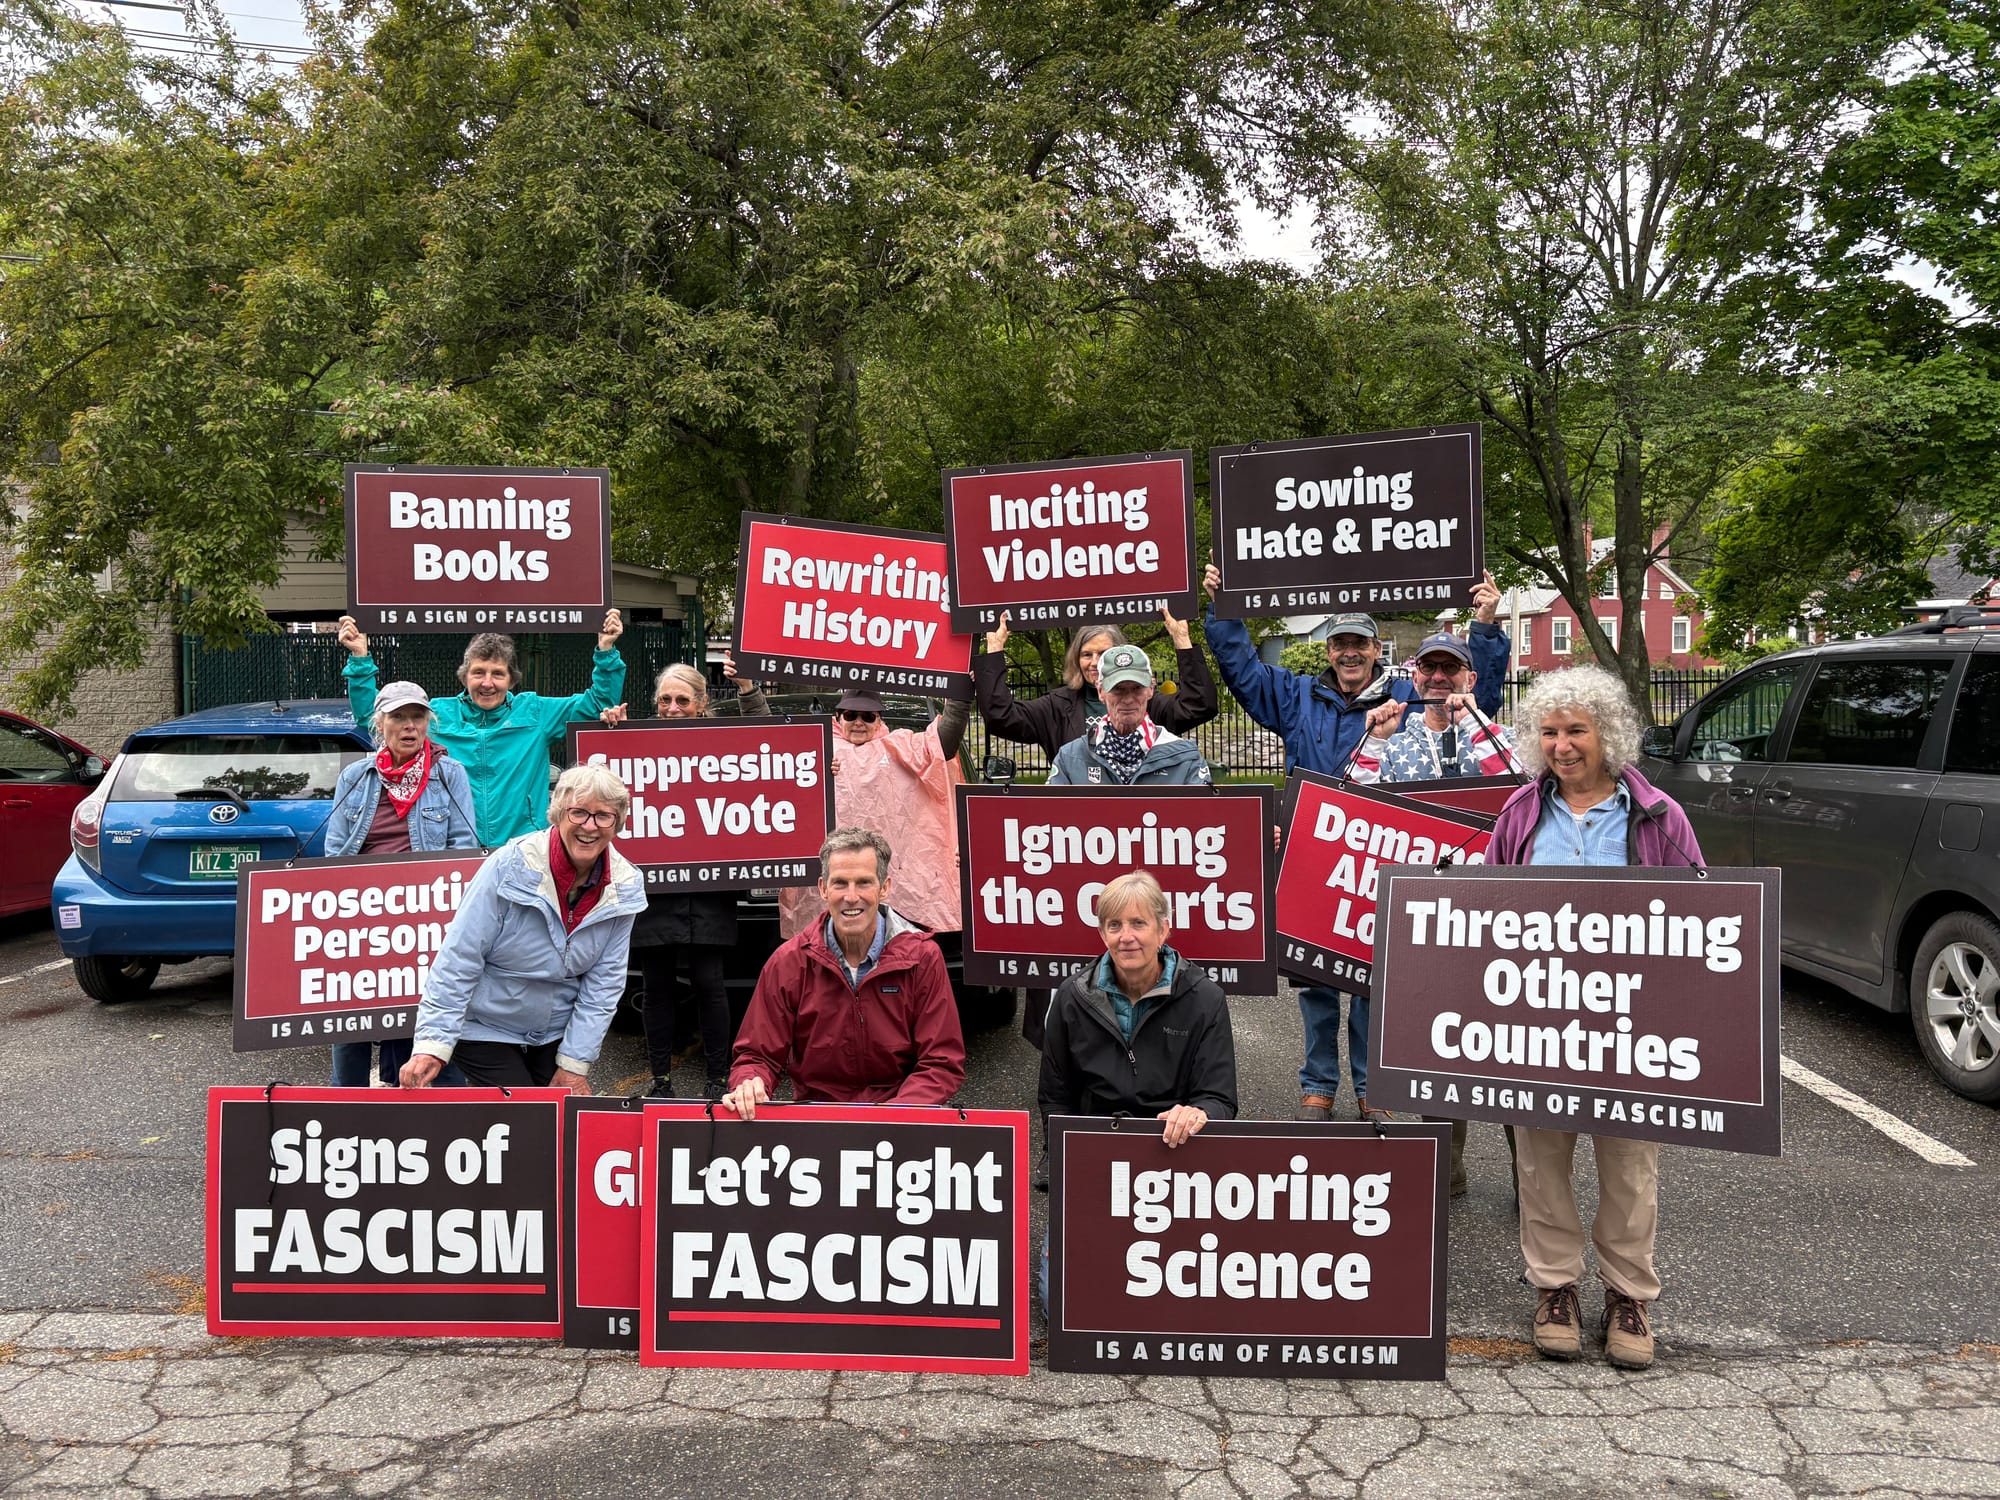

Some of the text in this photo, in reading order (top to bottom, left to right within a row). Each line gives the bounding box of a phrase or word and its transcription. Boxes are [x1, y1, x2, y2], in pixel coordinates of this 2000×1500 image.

[990, 481, 1149, 531] Inciting
[1276, 466, 1413, 511] Sowing
[390, 487, 571, 540] Banning
[414, 541, 549, 581] Books
[982, 538, 1159, 582] Violence
[1237, 518, 1458, 560] Hate & Fear
[381, 611, 582, 623] IS A SIGN OF FASCISM
[980, 611, 995, 622] IS
[1020, 606, 1058, 620] SIGN
[1067, 605, 1086, 617] OF
[1095, 599, 1168, 615] FASCISM
[1246, 585, 1450, 608] IS A SIGN OF FASCISM
[783, 599, 937, 659] History
[761, 659, 948, 688] IS A SIGN OF FASCISM
[696, 794, 795, 835] Vote
[196, 853, 221, 870] KTZ
[1004, 812, 1227, 878] Ignoring
[648, 864, 806, 883] SIGN OF FASCISM
[261, 871, 472, 923] Prosecuti
[980, 876, 1255, 930] the Crts
[294, 922, 451, 961] Person
[1406, 898, 1742, 972] Threatening
[1000, 960, 1088, 977] IS A SIG
[1287, 944, 1372, 985] IS A SIG
[1484, 957, 1642, 1013] Other
[272, 1013, 406, 1037] IS A SIGN OF
[1431, 1012, 1700, 1081] Countries
[1411, 1080, 1723, 1132] IS A SIGN OF FASCISM
[270, 1120, 510, 1198] Signs of
[672, 1141, 1002, 1225] Let's Fight
[1112, 1155, 1391, 1236] Ignoring
[236, 1209, 543, 1274] FASCISM
[673, 1232, 998, 1306] FASCISM
[1126, 1233, 1370, 1300] Science
[609, 1317, 630, 1335] IS
[1097, 1341, 1397, 1364] IS A SIGN OF FASCISM
